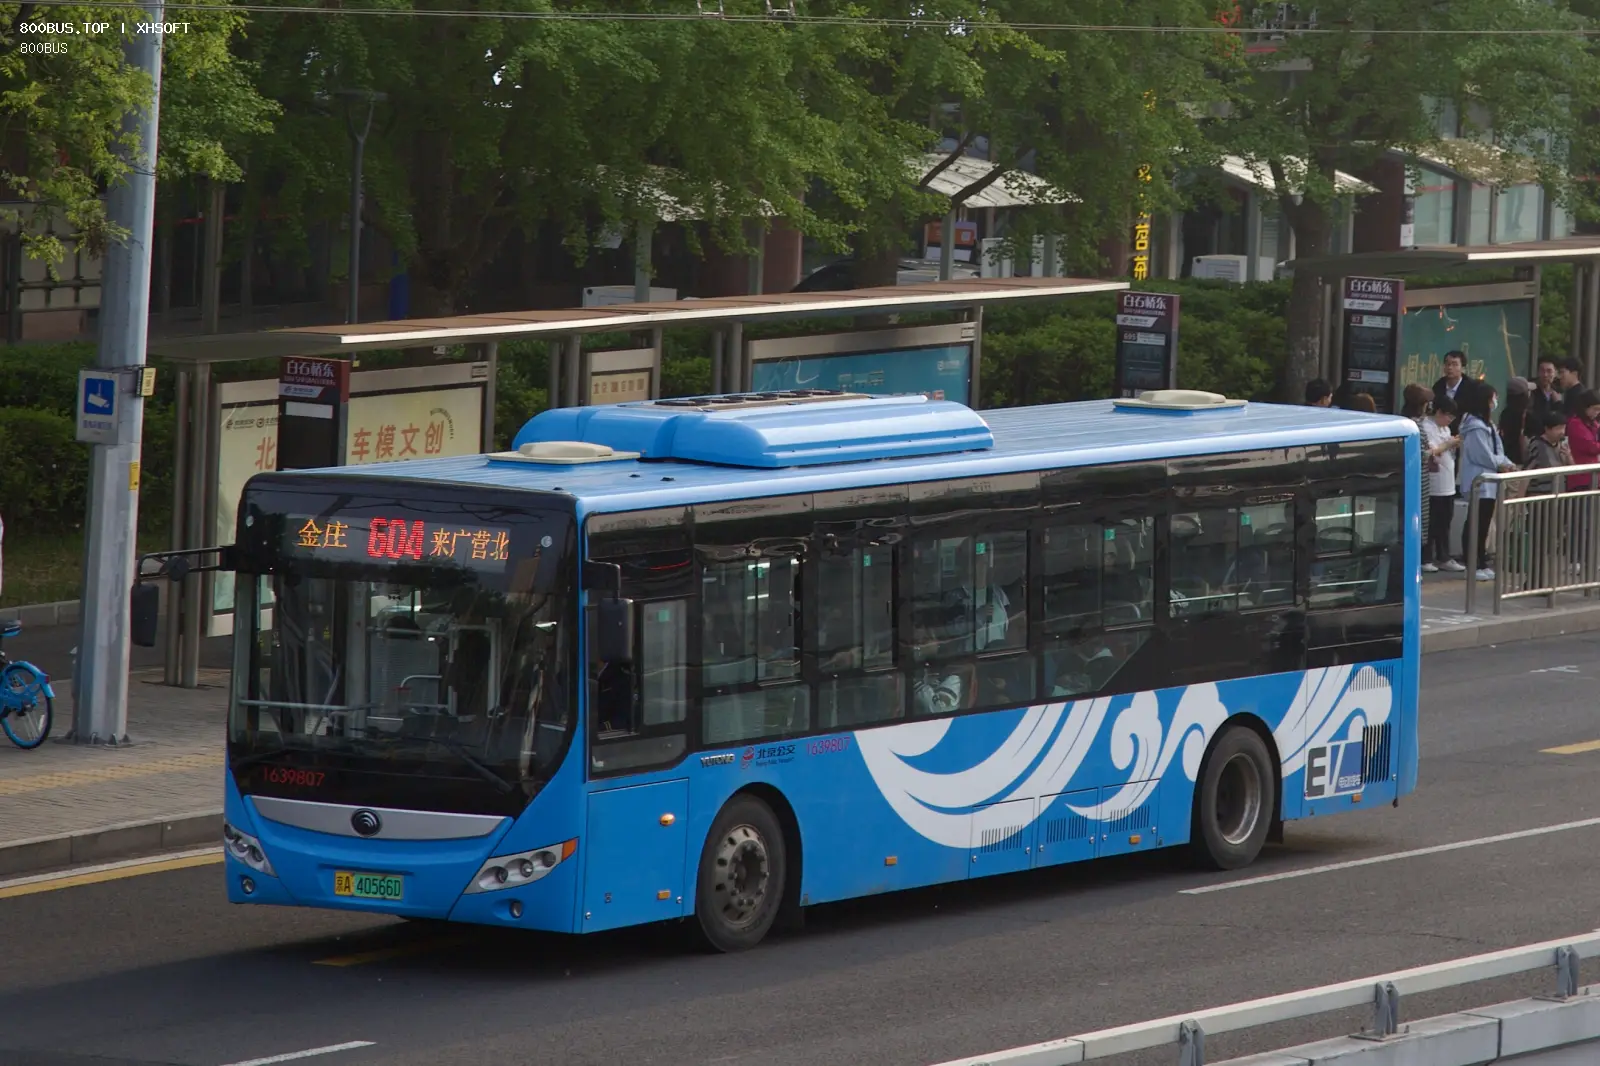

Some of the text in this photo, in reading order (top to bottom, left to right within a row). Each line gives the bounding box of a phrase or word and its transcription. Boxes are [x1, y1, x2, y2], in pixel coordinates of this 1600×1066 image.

[1350, 280, 1393, 294] 白石桥东
[1123, 294, 1166, 309] 白石桥东
[287, 360, 334, 378] 白石桥东
[255, 436, 276, 470] 北
[351, 421, 444, 460] 车模文创
[297, 517, 510, 561] 金庄 604 来广营北
[757, 745, 796, 760] 北京公交
[806, 737, 850, 756] 1639807
[262, 767, 325, 787] 1639807
[356, 877, 401, 897] 40566D
